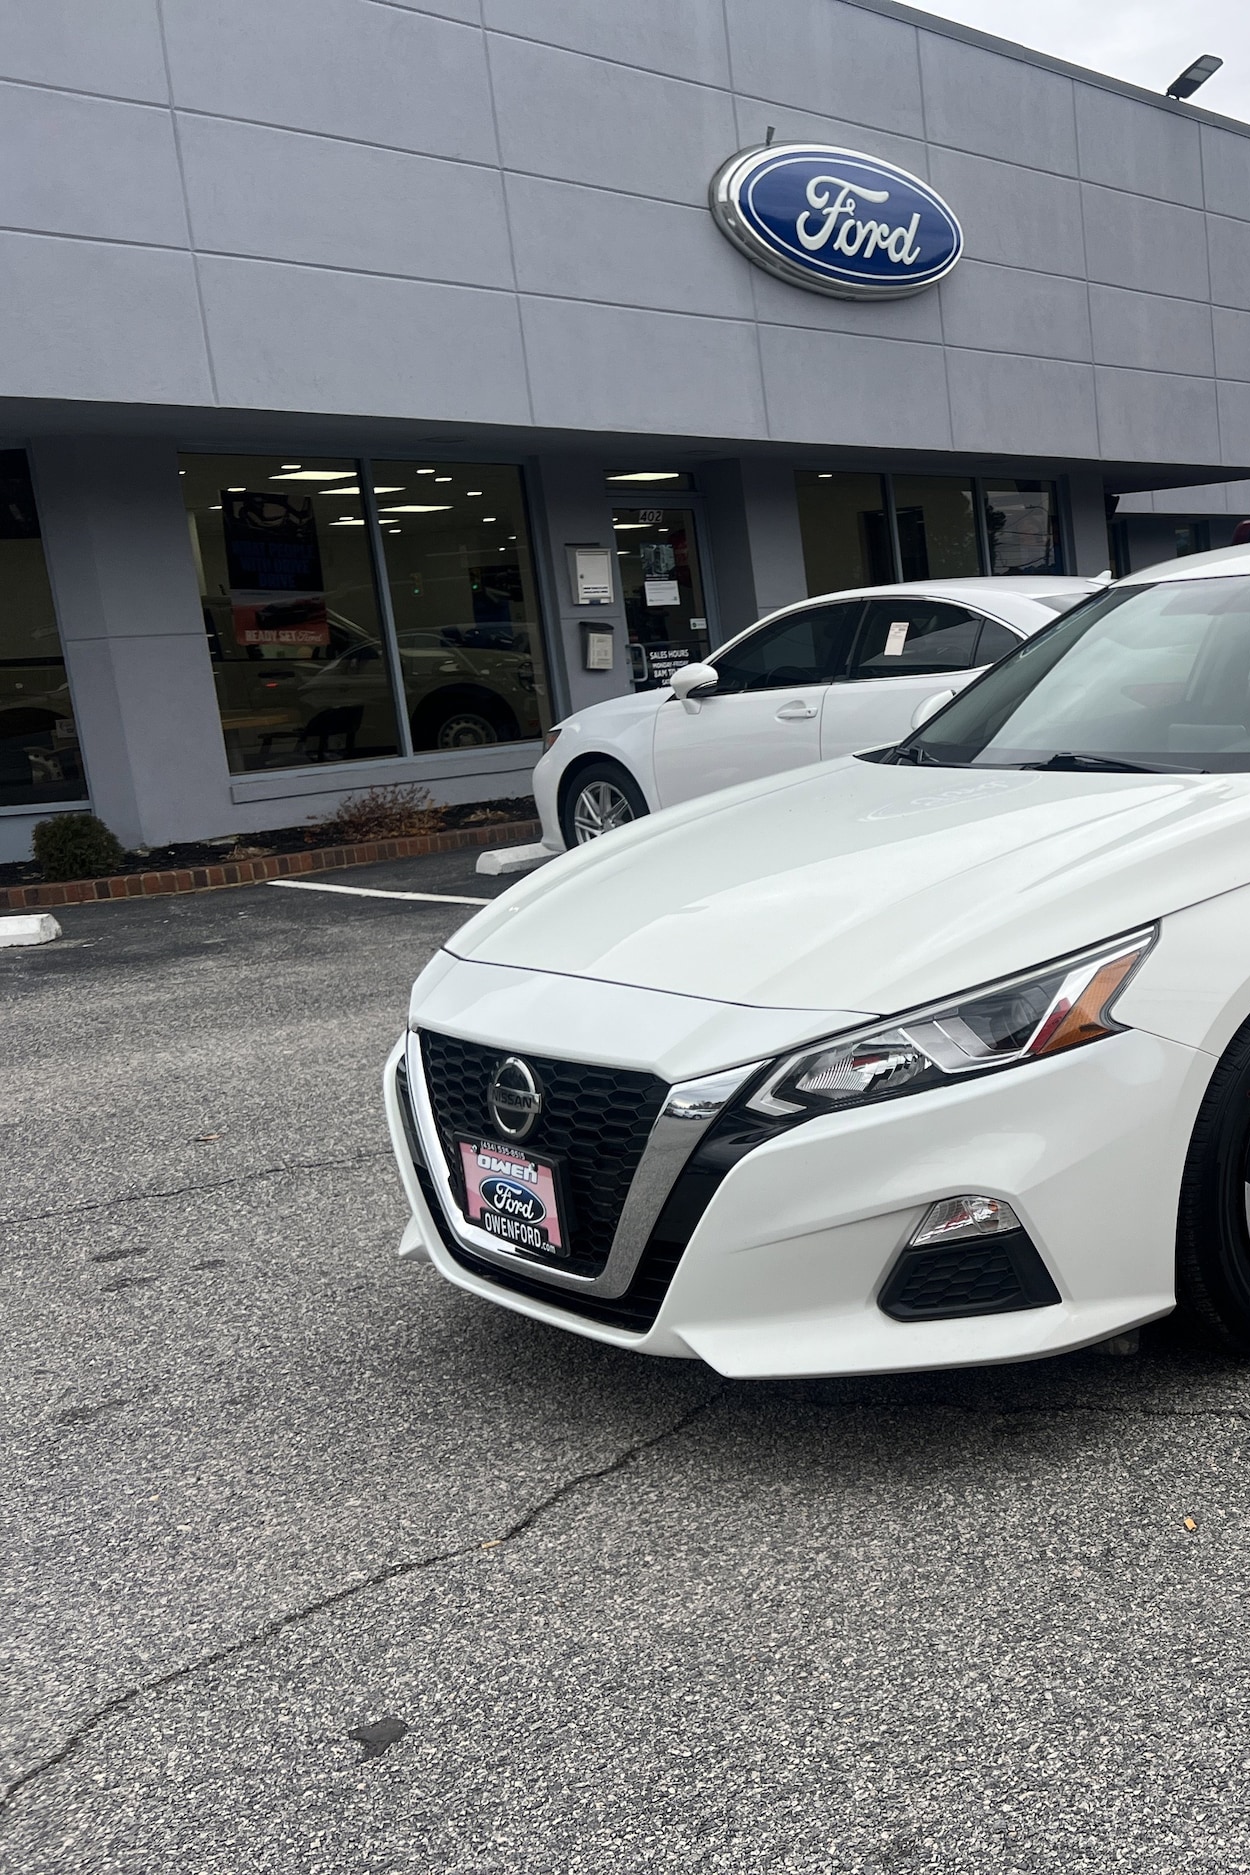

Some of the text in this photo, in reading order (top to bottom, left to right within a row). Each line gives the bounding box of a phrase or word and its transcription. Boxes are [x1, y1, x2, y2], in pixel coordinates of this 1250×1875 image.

[796, 175, 921, 265] Ford
[640, 511, 662, 522] 402
[244, 629, 323, 642] READY SET Ford
[649, 649, 690, 660] SALES HOURS
[492, 1088, 532, 1109] NISSAN
[493, 1182, 535, 1219] Ford
